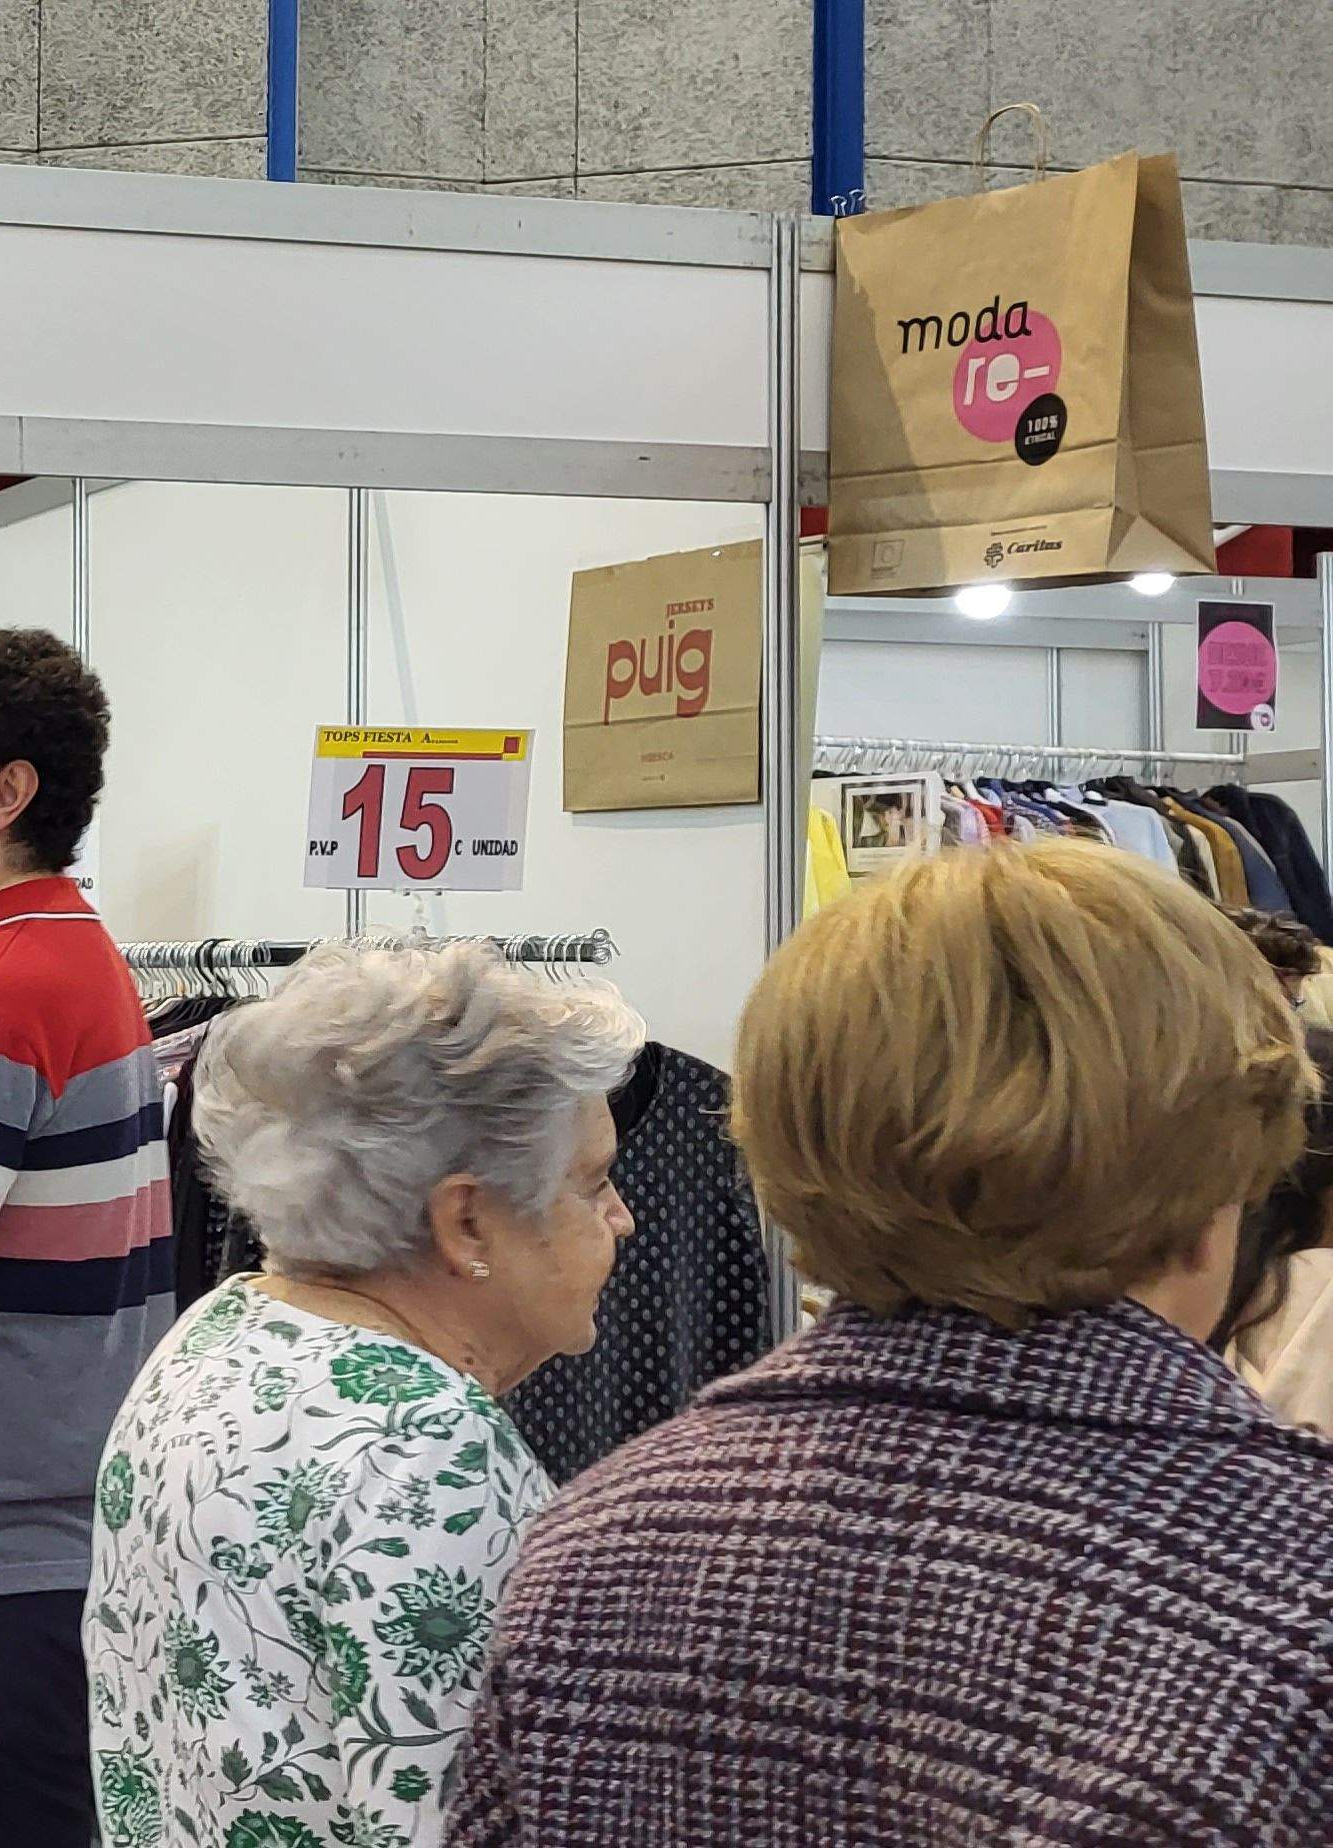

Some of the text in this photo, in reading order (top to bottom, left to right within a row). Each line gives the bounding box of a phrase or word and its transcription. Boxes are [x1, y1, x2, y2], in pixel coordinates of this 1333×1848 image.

[897, 295, 1032, 354] moda
[1028, 414, 1058, 433] 100%
[666, 598, 714, 618] JERSEYS
[604, 619, 713, 726] puig
[324, 730, 361, 742] TOPS
[363, 731, 412, 743] FIESTA
[309, 840, 338, 856] P.V.P
[342, 764, 454, 880] 15
[472, 839, 518, 856] UNIDAD
